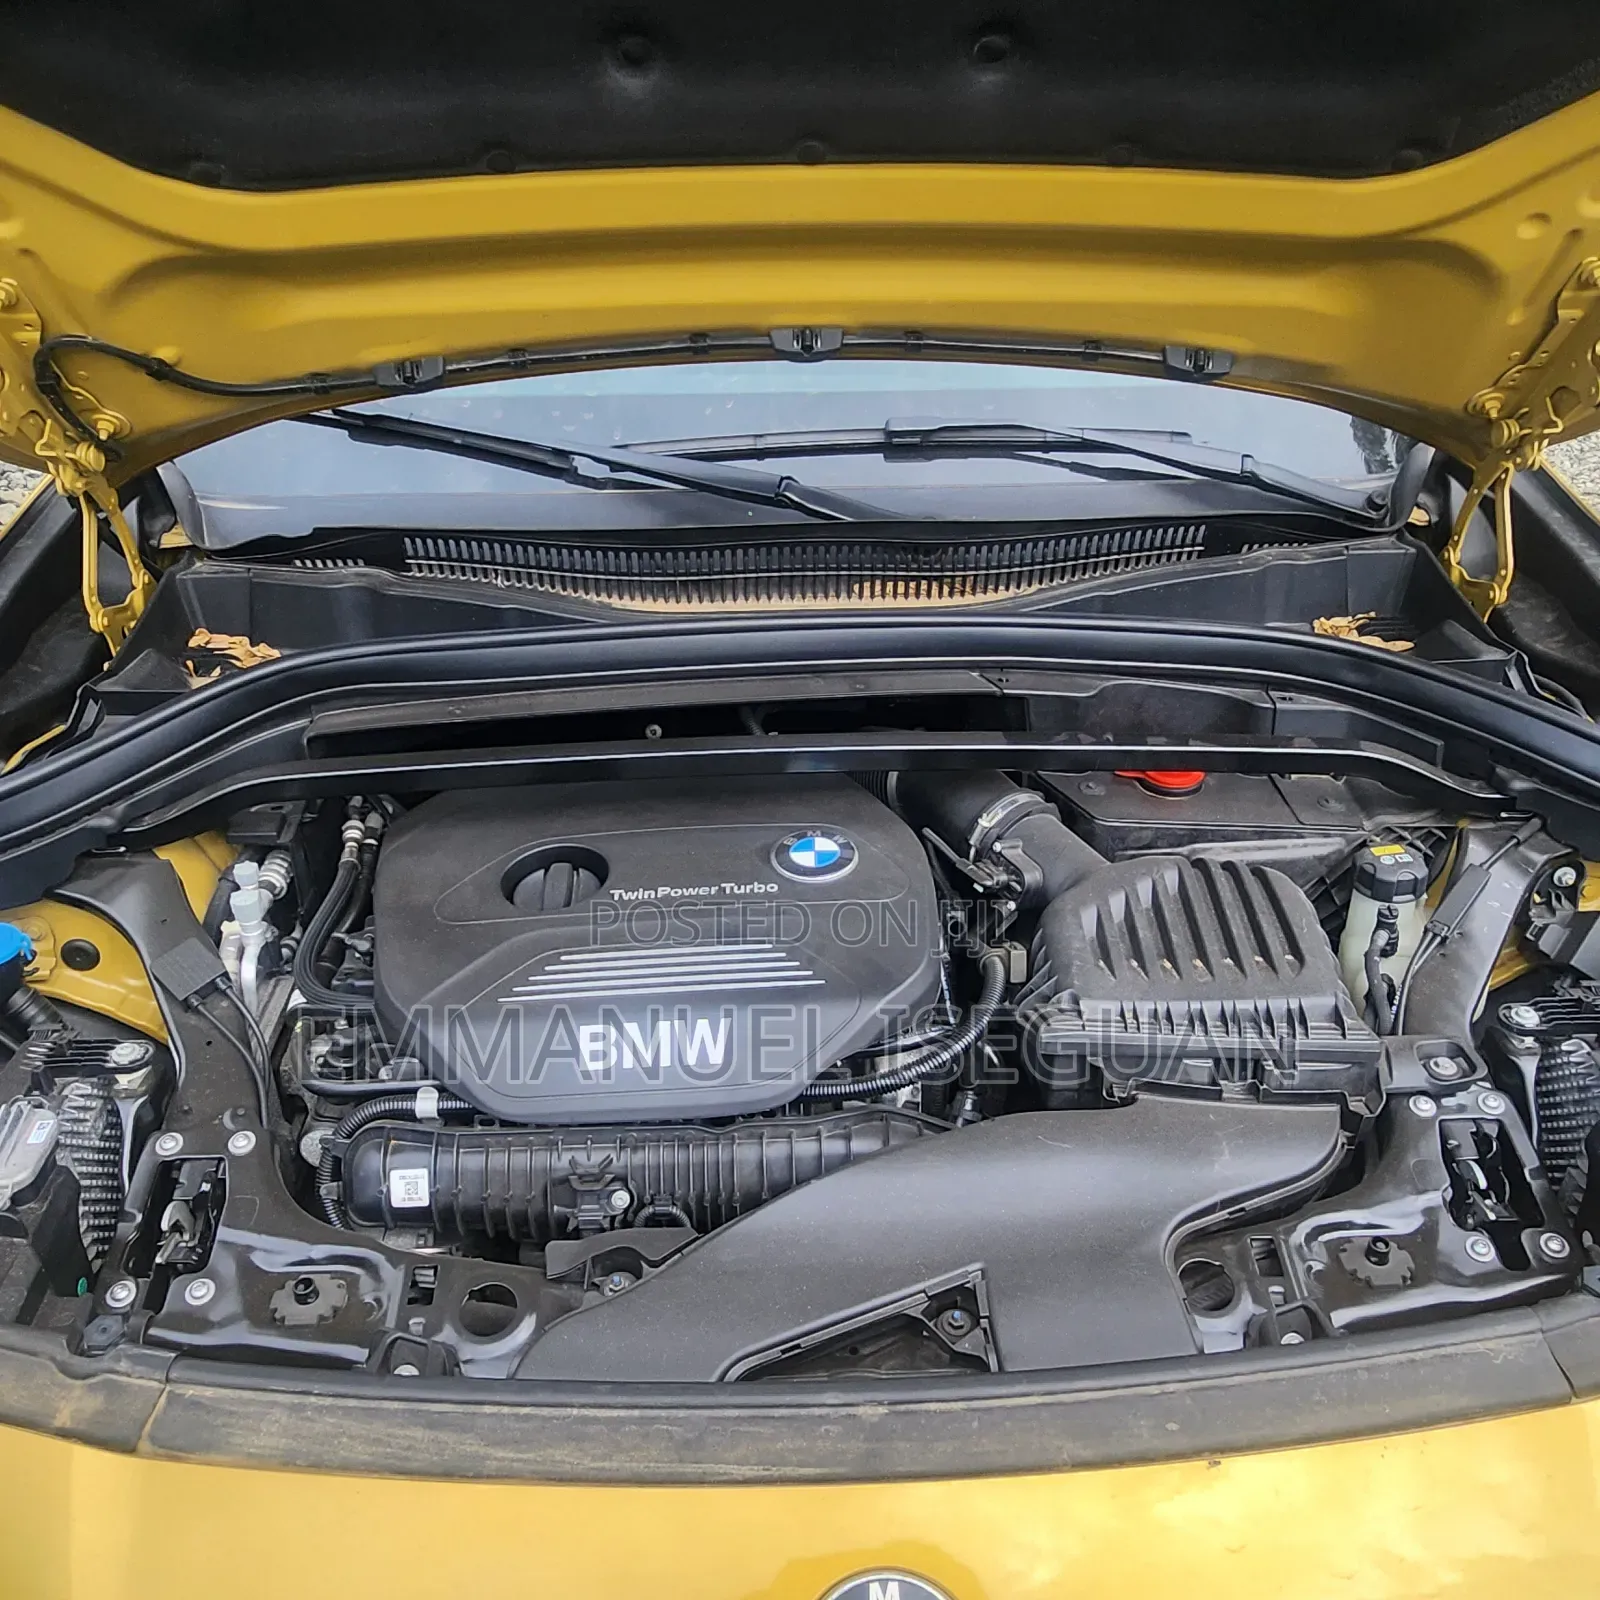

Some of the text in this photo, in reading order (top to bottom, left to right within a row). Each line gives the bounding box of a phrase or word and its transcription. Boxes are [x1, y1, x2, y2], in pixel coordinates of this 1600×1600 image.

[783, 830, 848, 846] BMW
[720, 881, 779, 895] Turbo
[578, 1017, 732, 1071] BMW
